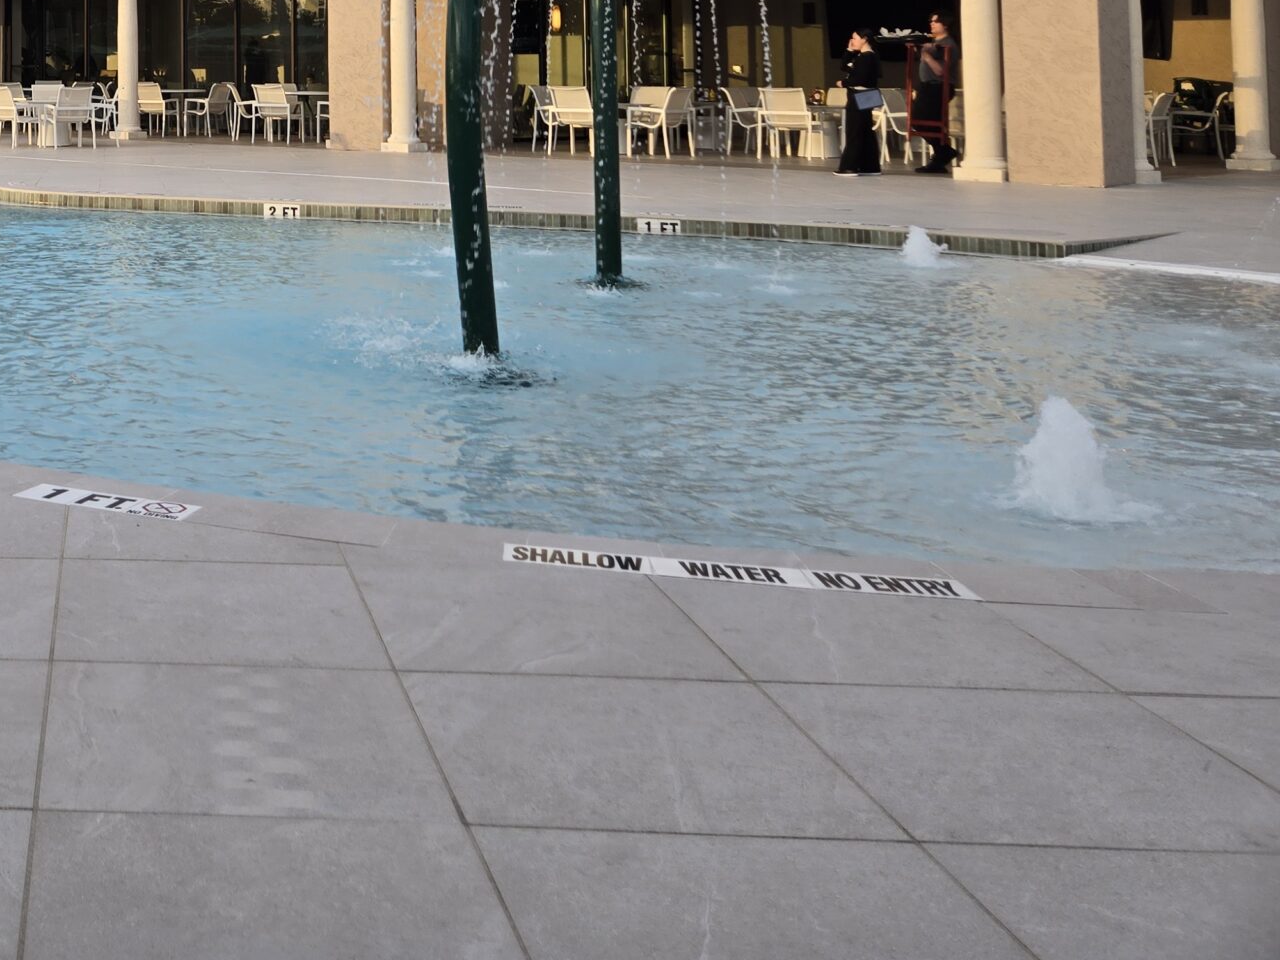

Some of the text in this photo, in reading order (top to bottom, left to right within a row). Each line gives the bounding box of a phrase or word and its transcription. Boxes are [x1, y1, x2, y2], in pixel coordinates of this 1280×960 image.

[269, 206, 298, 217] 2 FT
[644, 221, 678, 232] 1 FT
[42, 488, 137, 510] 1 FT.
[512, 546, 961, 597] SHALLOW WATER NO ENTRY
